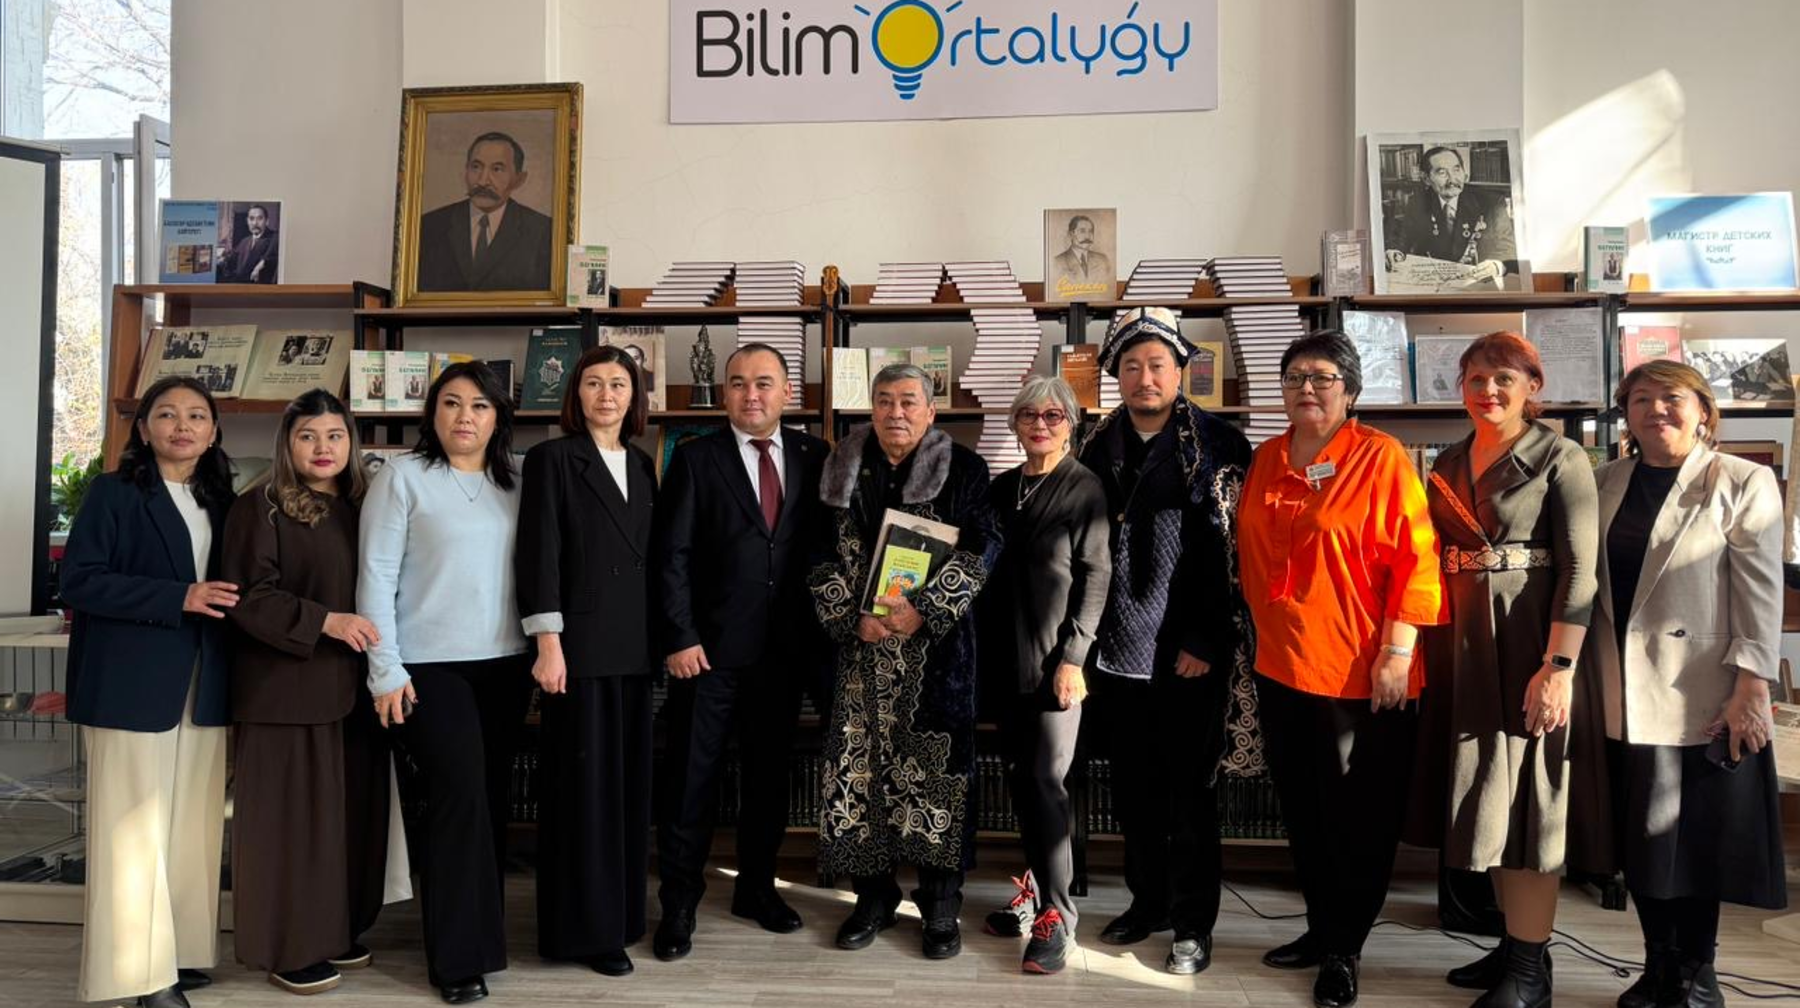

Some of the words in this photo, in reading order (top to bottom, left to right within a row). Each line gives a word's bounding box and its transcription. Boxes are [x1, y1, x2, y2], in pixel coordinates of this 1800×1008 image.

[695, 8, 859, 78] Bilim
[1666, 230, 1719, 241] МАГИСТР
[1722, 230, 1773, 241] ДЕТСКИХ
[1705, 243, 1734, 254] КНИГ
